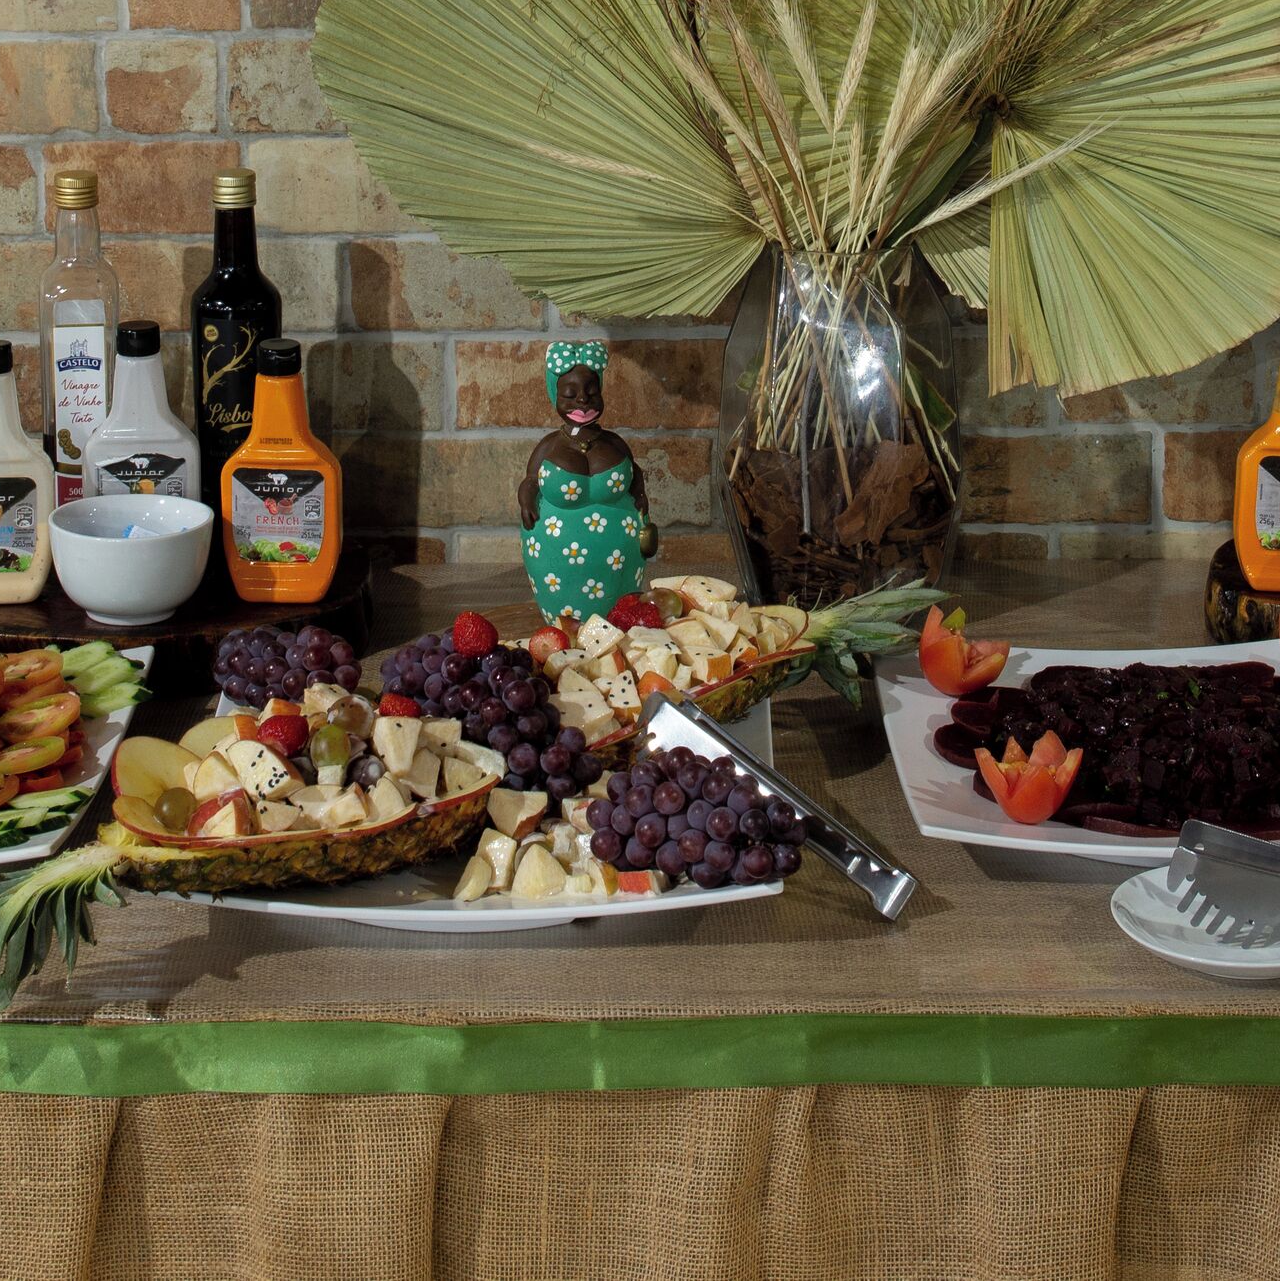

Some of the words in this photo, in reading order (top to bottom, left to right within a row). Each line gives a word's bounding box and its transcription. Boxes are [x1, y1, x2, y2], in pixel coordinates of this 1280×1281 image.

[60, 358, 99, 368] CASTELO
[61, 379, 100, 394] Vinagre
[58, 396, 71, 407] de
[74, 395, 103, 407] Vinho
[70, 412, 94, 423] Tinto
[205, 402, 253, 427] Lisbo
[256, 515, 300, 526] FRENCH
